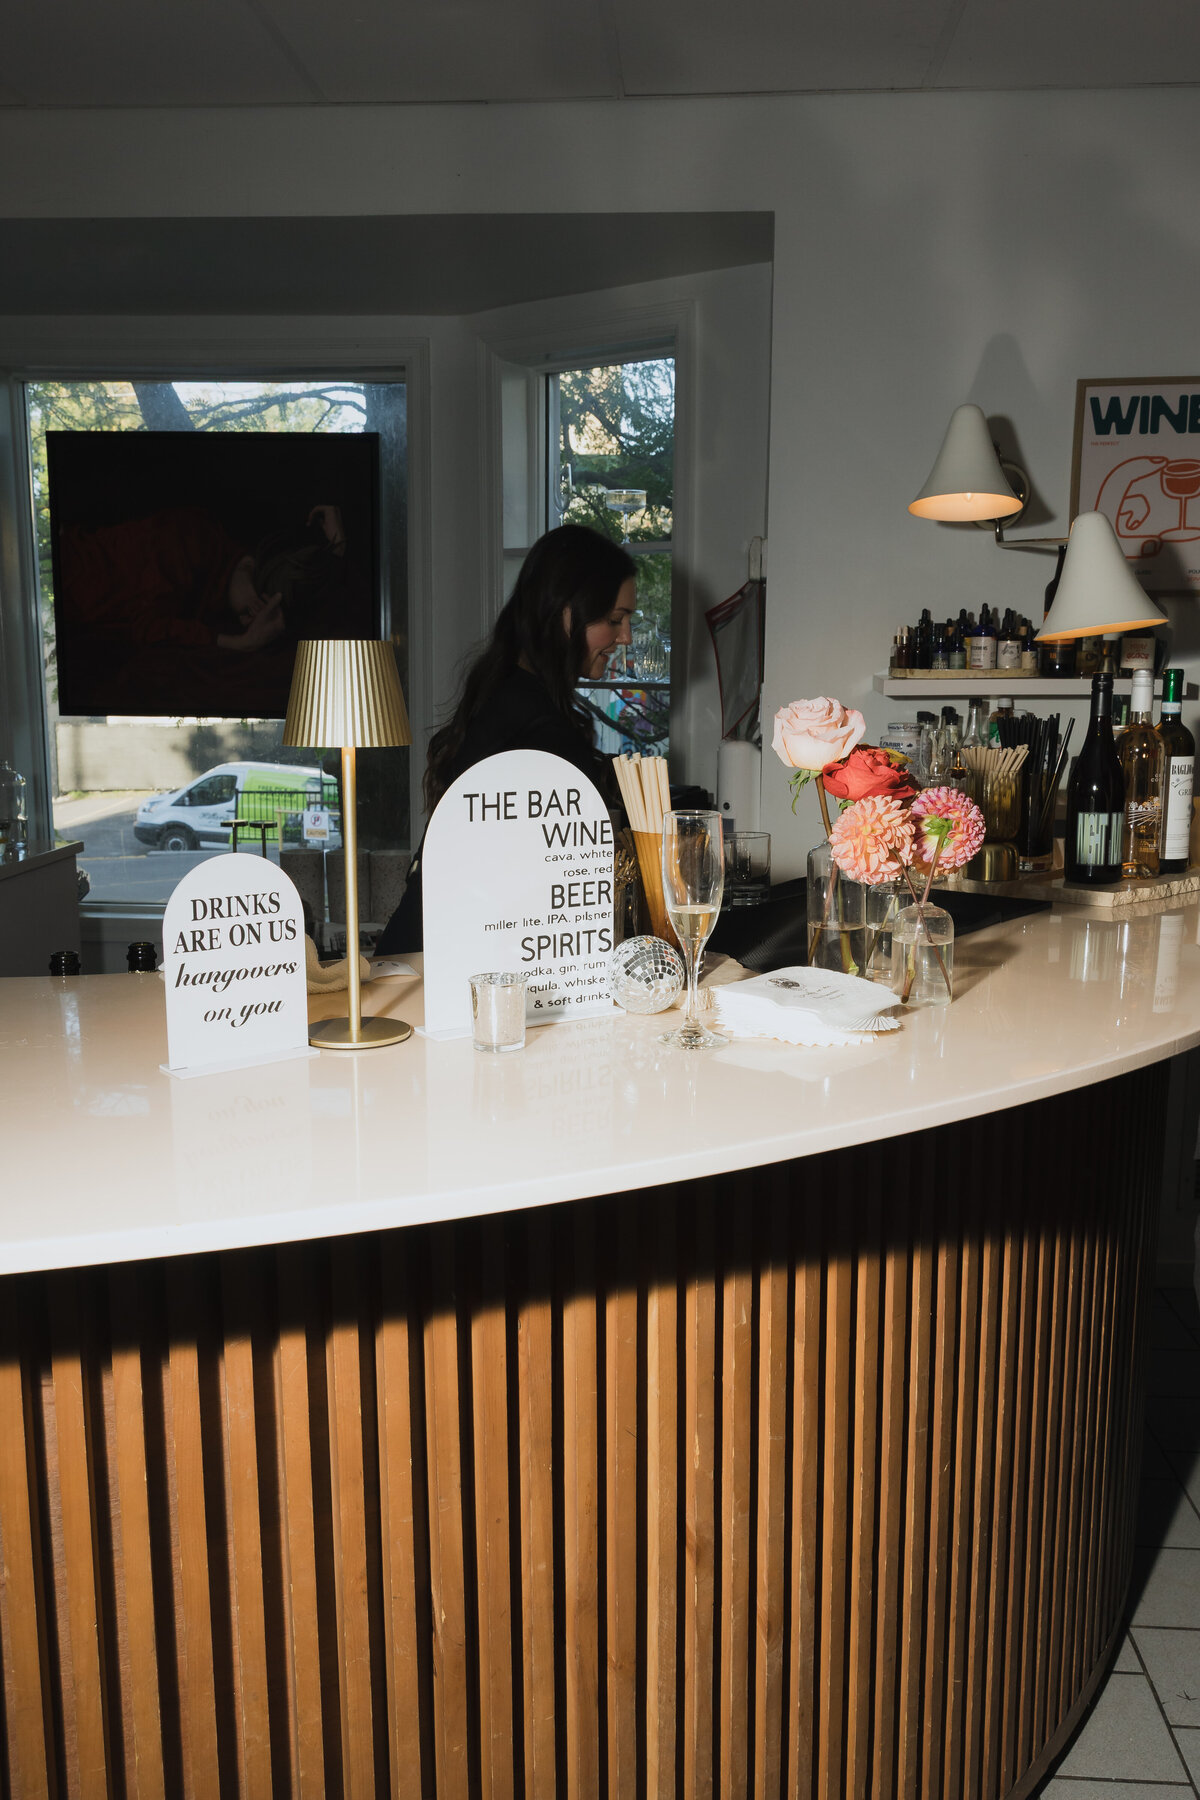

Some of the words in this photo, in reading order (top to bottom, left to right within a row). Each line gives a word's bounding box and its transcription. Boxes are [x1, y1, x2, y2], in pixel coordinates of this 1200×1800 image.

[463, 791, 518, 823] THE
[527, 788, 582, 819] BAR
[541, 819, 613, 849] WINE
[579, 849, 613, 860] white
[594, 864, 613, 874] red
[190, 891, 281, 921] DRINKS
[551, 880, 612, 910] BEER
[173, 928, 222, 955] ARE
[228, 922, 263, 948] ON
[267, 918, 298, 943] US
[484, 919, 518, 932] miller
[574, 911, 612, 924] pilsner
[520, 928, 613, 963] SPIRITS
[174, 961, 301, 993] hangovers
[564, 975, 608, 989] whiske
[203, 1007, 232, 1023] on
[230, 1000, 285, 1028] you
[533, 999, 544, 1009] &
[547, 996, 572, 1008] soft
[575, 991, 611, 1004] drinks
